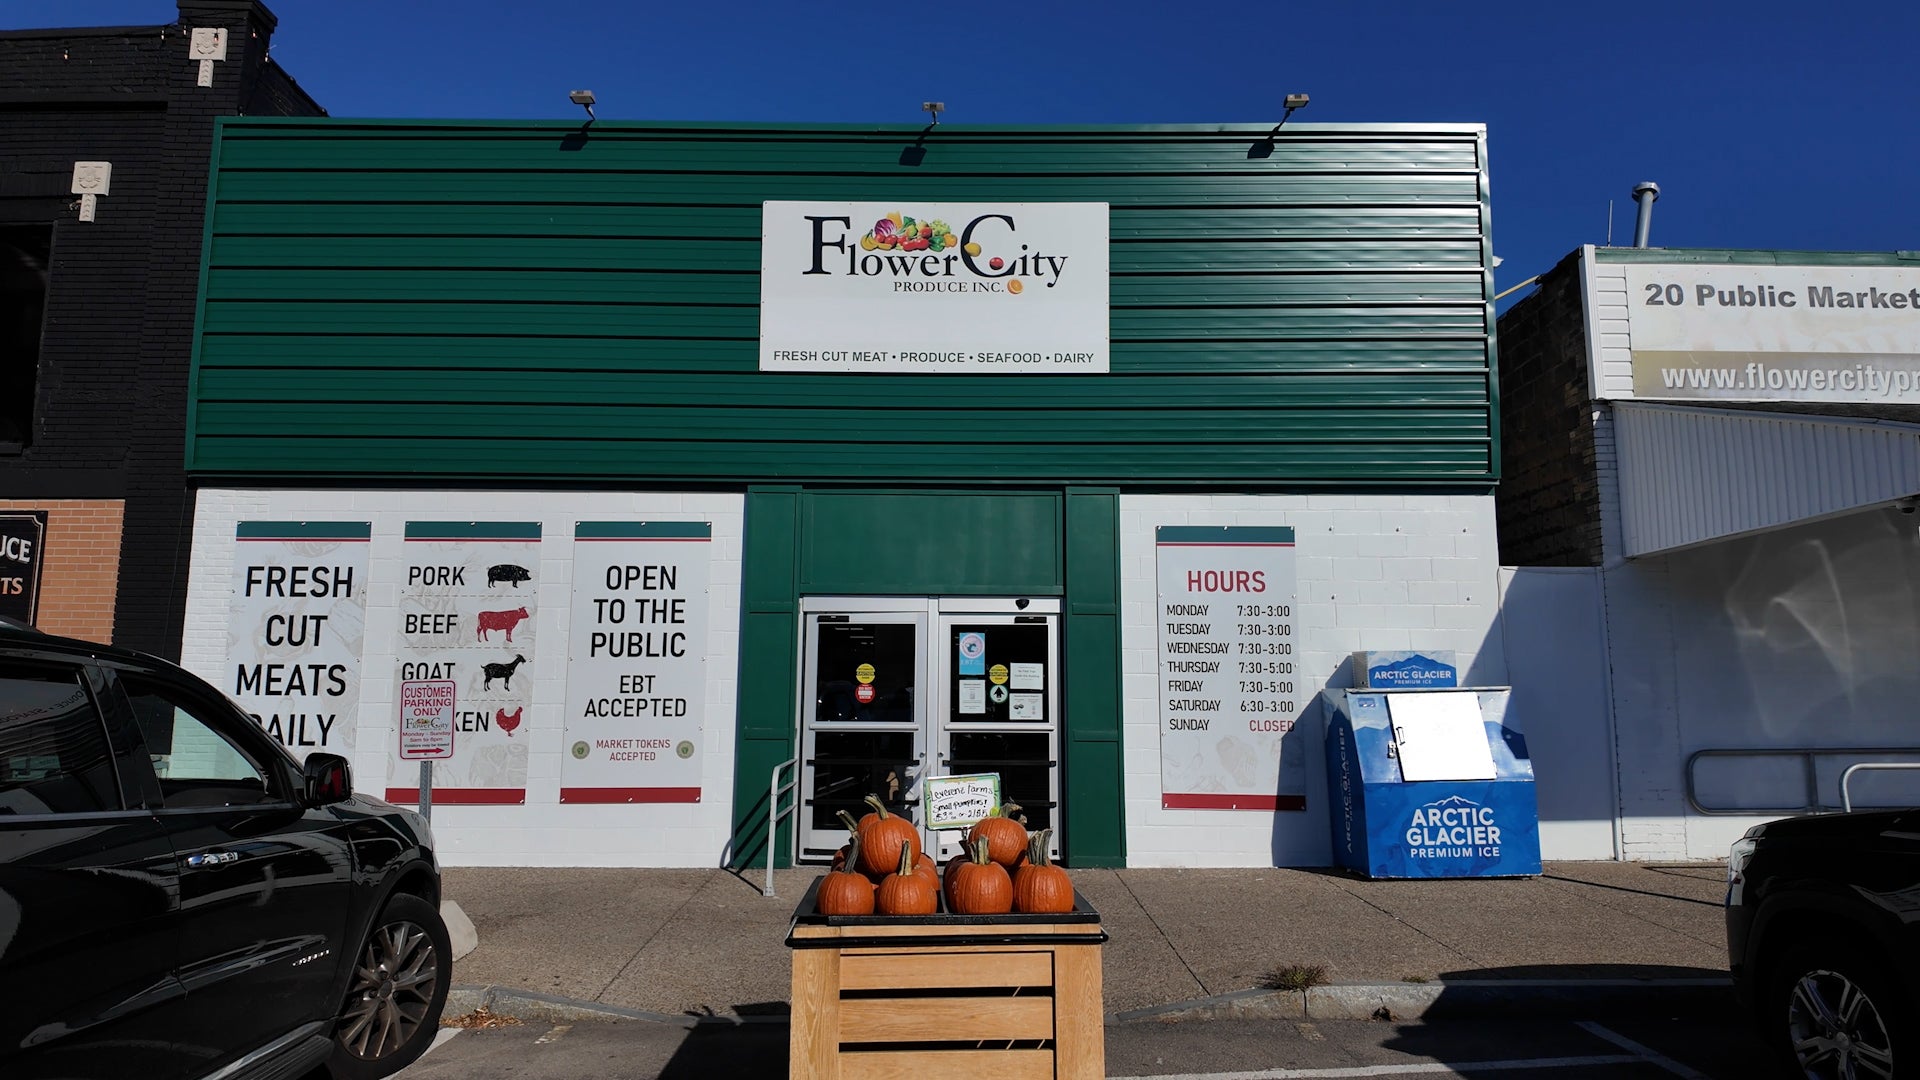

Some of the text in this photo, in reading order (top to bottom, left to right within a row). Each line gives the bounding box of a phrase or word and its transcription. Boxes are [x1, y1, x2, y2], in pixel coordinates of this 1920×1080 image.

[894, 281, 1004, 293] PRODUCE INC.
[1644, 283, 1920, 310] 20 Public Market
[773, 350, 1094, 363] FRESH CUT MEAT PRODUCE SEAFOOD DAIRY
[245, 565, 354, 598] FRESH
[408, 566, 466, 586] PORK
[606, 565, 677, 591] OPEN
[1187, 570, 1266, 593] HOURS
[593, 598, 686, 624] TO THE
[1166, 604, 1290, 617] MONDAY 7:30-3:00
[265, 614, 329, 647] CUT
[405, 613, 459, 634] BEEF
[1166, 623, 1291, 636] TUESDAY 7:30-3:00
[590, 632, 686, 658] PUBLIC
[1167, 642, 1292, 655] WEDNESDAY 7:30-3:00
[402, 662, 456, 680] GOAT
[1167, 660, 1292, 674] THURSDAY 7:30-5:00
[236, 663, 347, 697] MEATS
[1374, 670, 1452, 680] ARCTIC GLACIER
[619, 674, 656, 694] EBT
[1168, 680, 1293, 694] FRIDAY 7:30-5:00
[404, 687, 452, 698] CUSTOMER
[404, 699, 452, 707] PARKING
[583, 698, 687, 718] ACCEPTED
[1169, 699, 1294, 713] SATURDAY 6:30-3:00
[413, 708, 442, 716] ONLY
[252, 713, 337, 748] AILY
[1169, 718, 1295, 732] SUNDAY CLOSED
[596, 739, 671, 749] MARKET TOKENS
[609, 751, 656, 761] ACCEPTED
[933, 801, 952, 813] Small
[1411, 807, 1495, 827] ARCTIC
[1405, 826, 1502, 846] GLACIER
[1410, 846, 1501, 858] PREMIUM ICE
